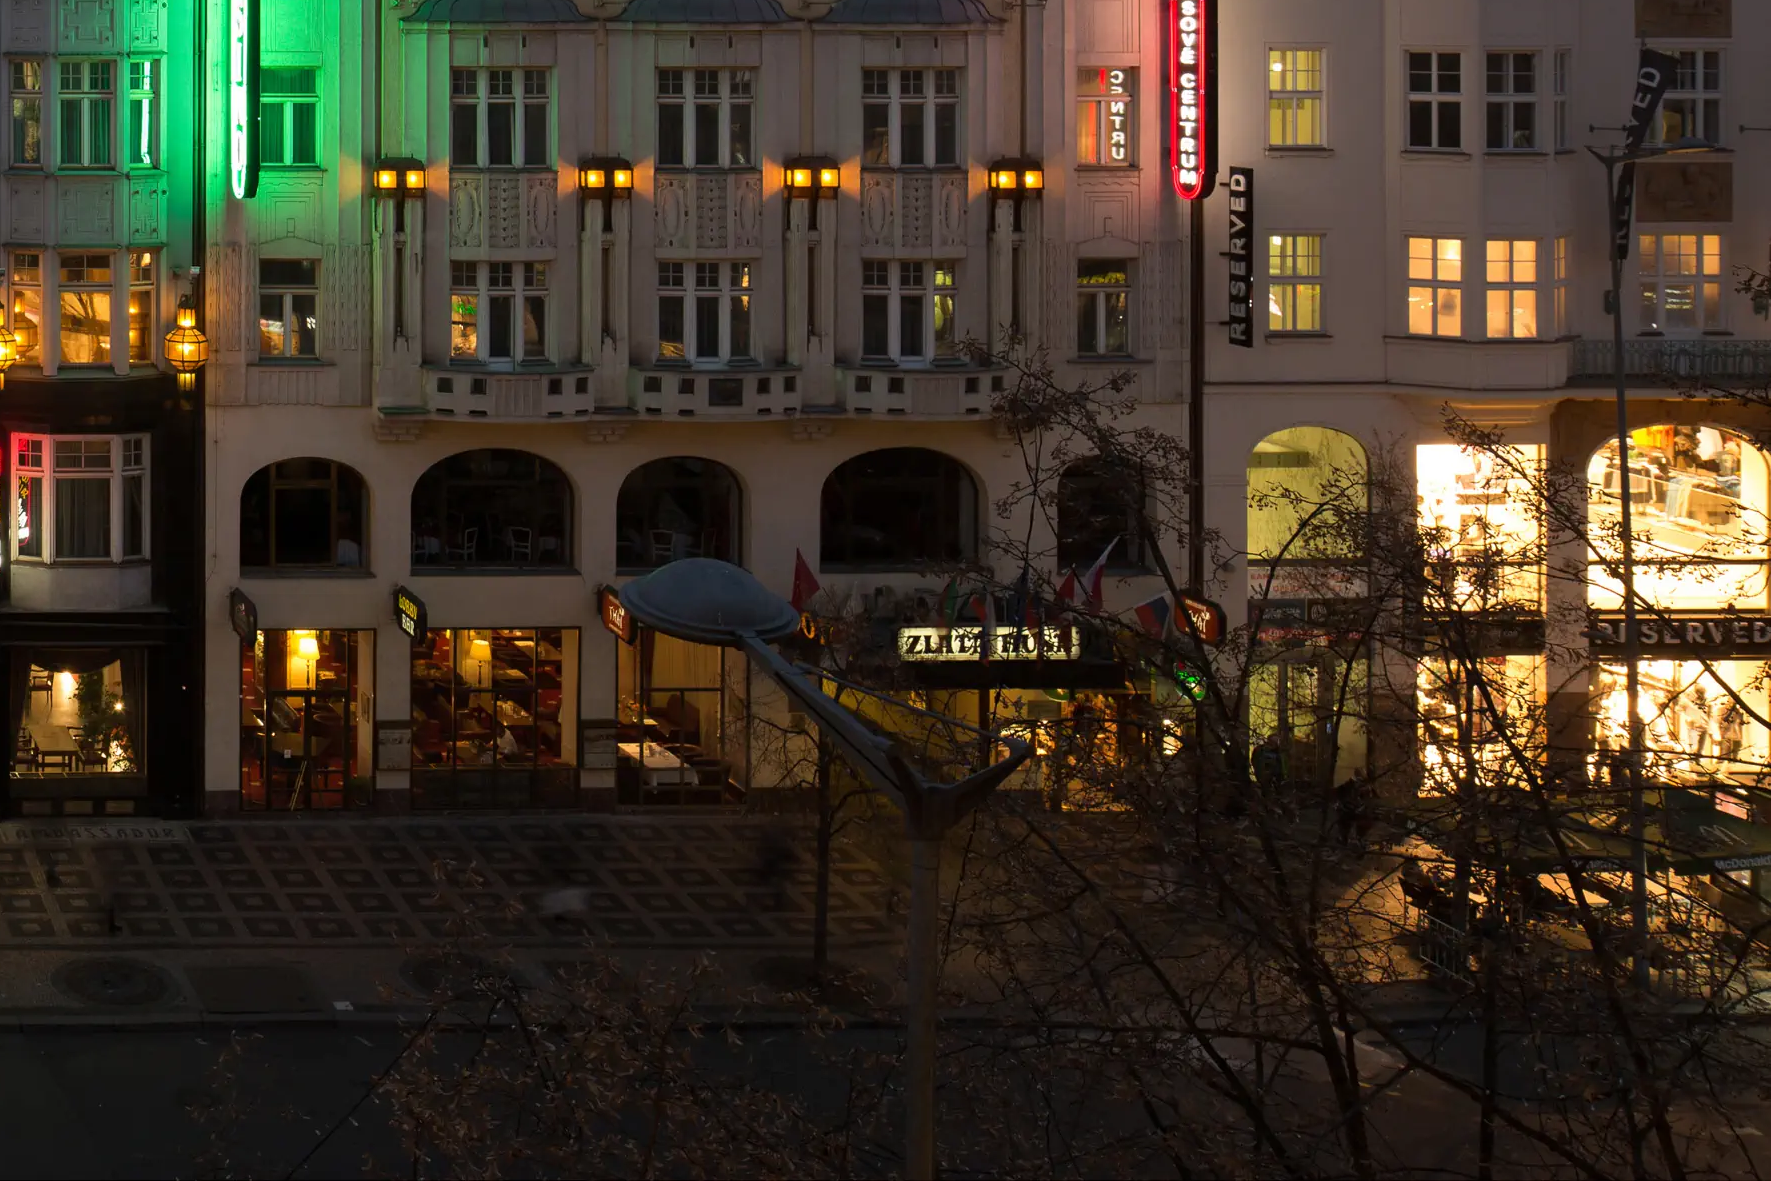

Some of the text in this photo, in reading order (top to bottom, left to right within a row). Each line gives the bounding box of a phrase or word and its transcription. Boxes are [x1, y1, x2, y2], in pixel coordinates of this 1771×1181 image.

[1178, 72, 1199, 185] CENTRUM
[1230, 174, 1247, 343] RESERVED
[402, 613, 415, 636] BAR
